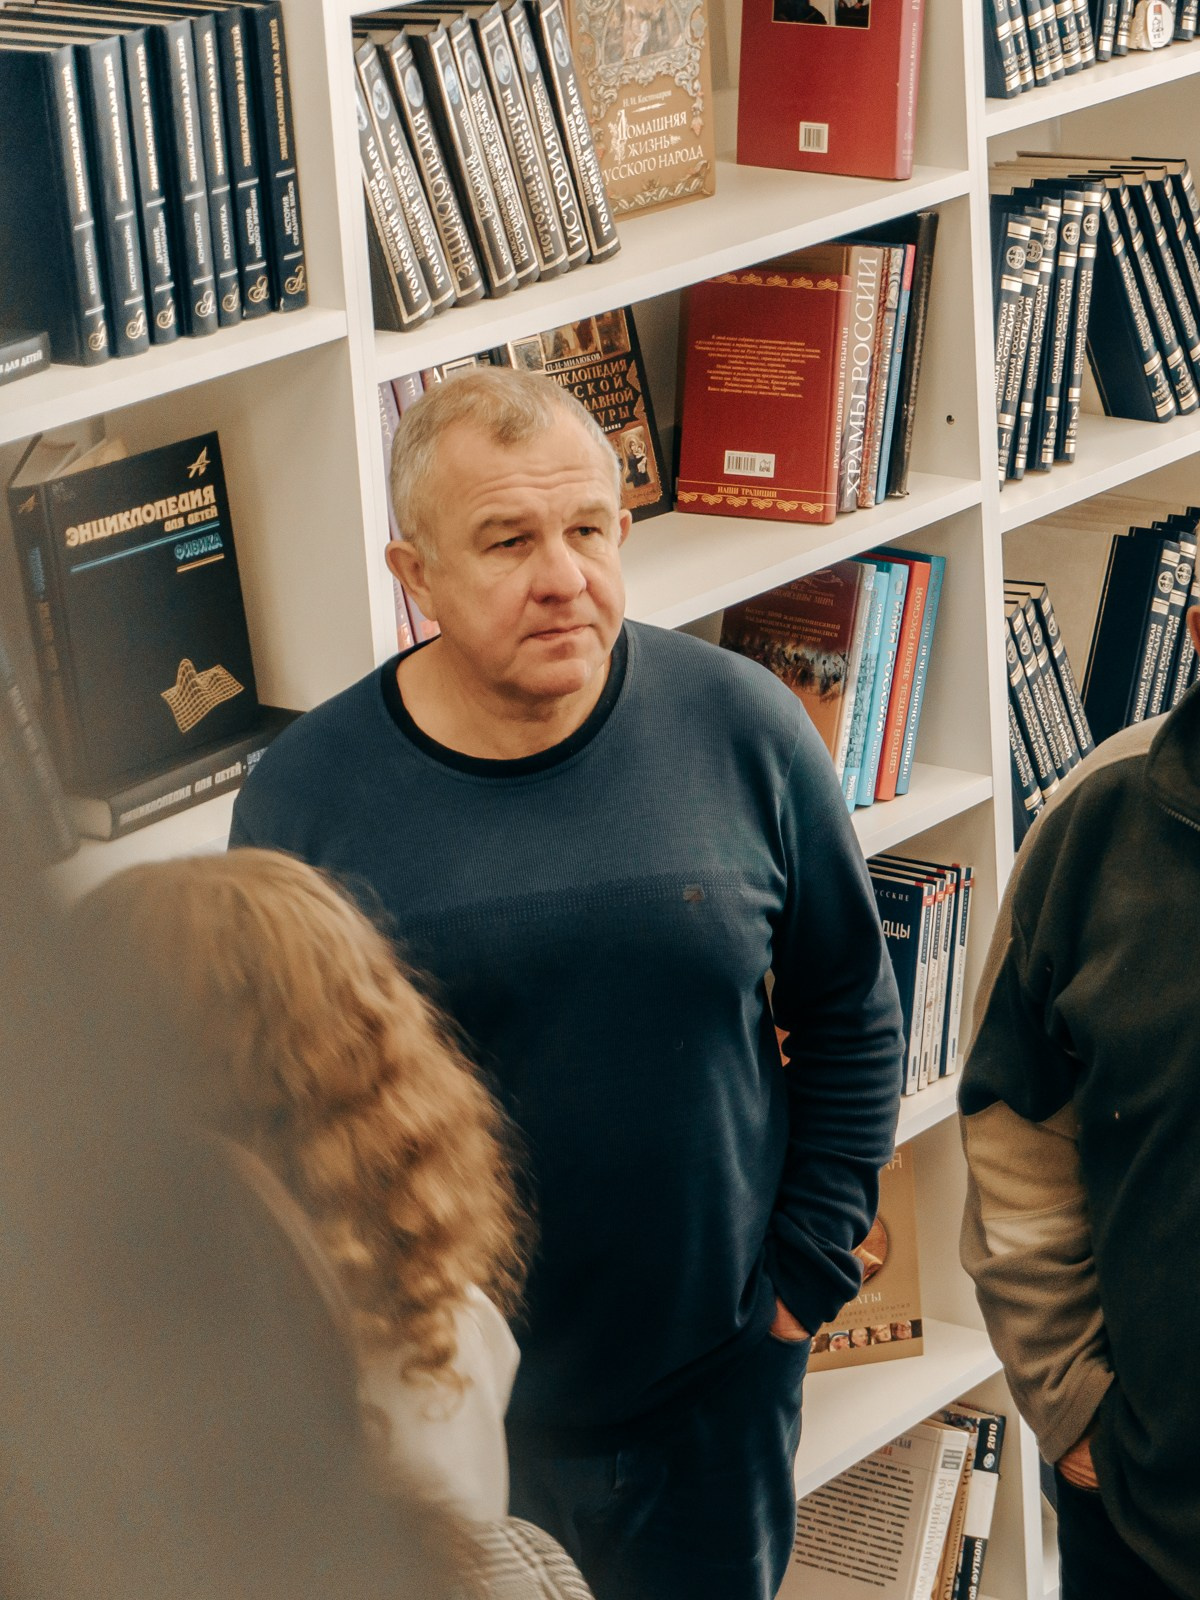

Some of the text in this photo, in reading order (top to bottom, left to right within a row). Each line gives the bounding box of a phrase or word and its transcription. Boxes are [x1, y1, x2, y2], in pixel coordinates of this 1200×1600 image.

[231, 24, 251, 167] ЭНЦИКЛОПЕДИЯ ДЛЯ ДЕТЕЙ
[269, 18, 288, 161] ЭНЦИКЛОПЕДИЯ ДЛЯ ДЕТЕЙ
[501, 87, 555, 257] ИСТОРИЯ КУЛЬТУРЫ
[567, 74, 611, 236] ТОЛКОВЫЙ СЛОВАРЬ
[628, 135, 670, 157] ЖИЗНЬ
[659, 145, 703, 168] НАРОДА
[282, 195, 292, 235] ИСТОРИЯ
[389, 124, 445, 288] ТОЛКОВЫЙ СЛОВАРЬ
[410, 108, 473, 280] ЭНЦИКЛОПЕДИЯ
[542, 131, 583, 247] ИСТОРИЯ
[220, 203, 231, 260] ПОЛИТИКА
[366, 136, 422, 302] ТОЛКОВЫЙ СЛОВАРЬ
[995, 301, 1008, 361] РОССИЙСКАЯ
[1011, 296, 1033, 402] ЭНЦИКЛОПЕДИЯ
[1026, 283, 1042, 388] БОЛЬШАЯ РОССИЙСКАЯ
[1051, 278, 1066, 383] БОЛЬШАЯ РОССИЙСКАЯ
[1073, 270, 1086, 374] БОЛЬШАЯ РОССИЙСКАЯ
[552, 359, 627, 387] ИКЛОПЕДИЯ
[574, 374, 623, 398] СКОЙ
[583, 387, 634, 411] ЛАВНОЙ
[836, 381, 844, 420] ОБРЯДЫ
[845, 256, 879, 498] ХРАМЫ РОССИИ
[1004, 357, 1016, 401] БОЛЬШАЯ
[833, 423, 842, 468] РУССКИЕ
[65, 484, 216, 547] ЭНЦИКЛОПЕДИЯ
[164, 505, 218, 532] ДЛЯ ДЕТЕЙ
[717, 485, 777, 497] НАШИ ТРАДИЦИИ
[174, 532, 223, 560] ФИЗИКА
[888, 600, 902, 643] ИМЯ
[875, 649, 894, 732] РОССИЯ
[888, 728, 901, 774] СВЯТОЙ
[902, 642, 914, 680] ЗЕМЛИ
[908, 586, 922, 639] РУССКОЙ
[901, 732, 913, 778] ПЕРВЫЙ
[877, 890, 910, 902] УССКИЕ
[987, 1423, 997, 1449] 2010
[962, 1452, 972, 1486] ИГР
[920, 1477, 946, 1571] ОЛИМПИЙСКАЯ
[970, 1537, 983, 1583] ФУТБОЛ:
